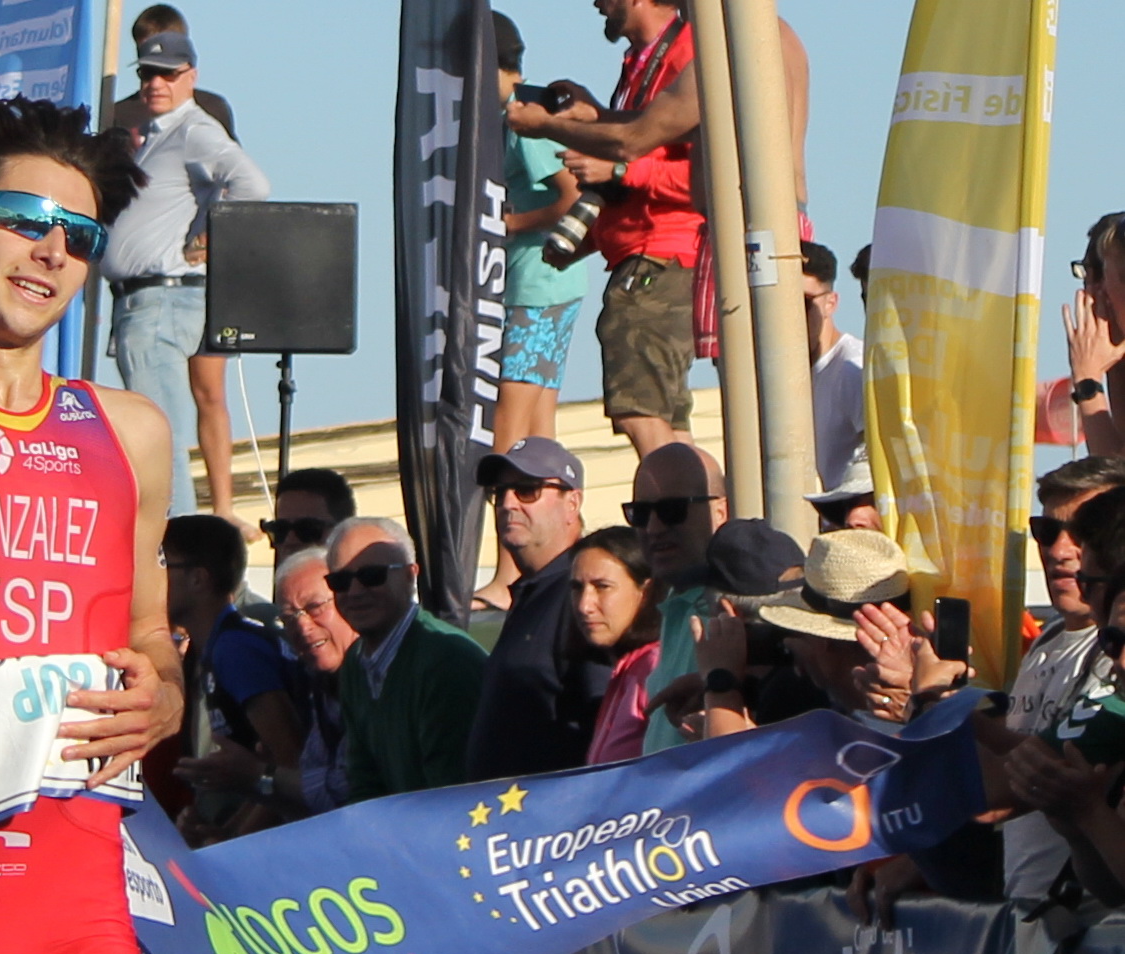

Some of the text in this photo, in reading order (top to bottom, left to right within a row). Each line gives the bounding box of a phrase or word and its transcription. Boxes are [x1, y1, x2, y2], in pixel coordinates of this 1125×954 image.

[469, 177, 508, 447] FINISH
[18, 439, 78, 461] LaLiga
[22, 456, 82, 475] 4Sports
[881, 802, 924, 834] ITU
[486, 807, 663, 876] European
[126, 867, 165, 904] esporto
[498, 829, 721, 931] Triathlon
[651, 875, 751, 908] Union
